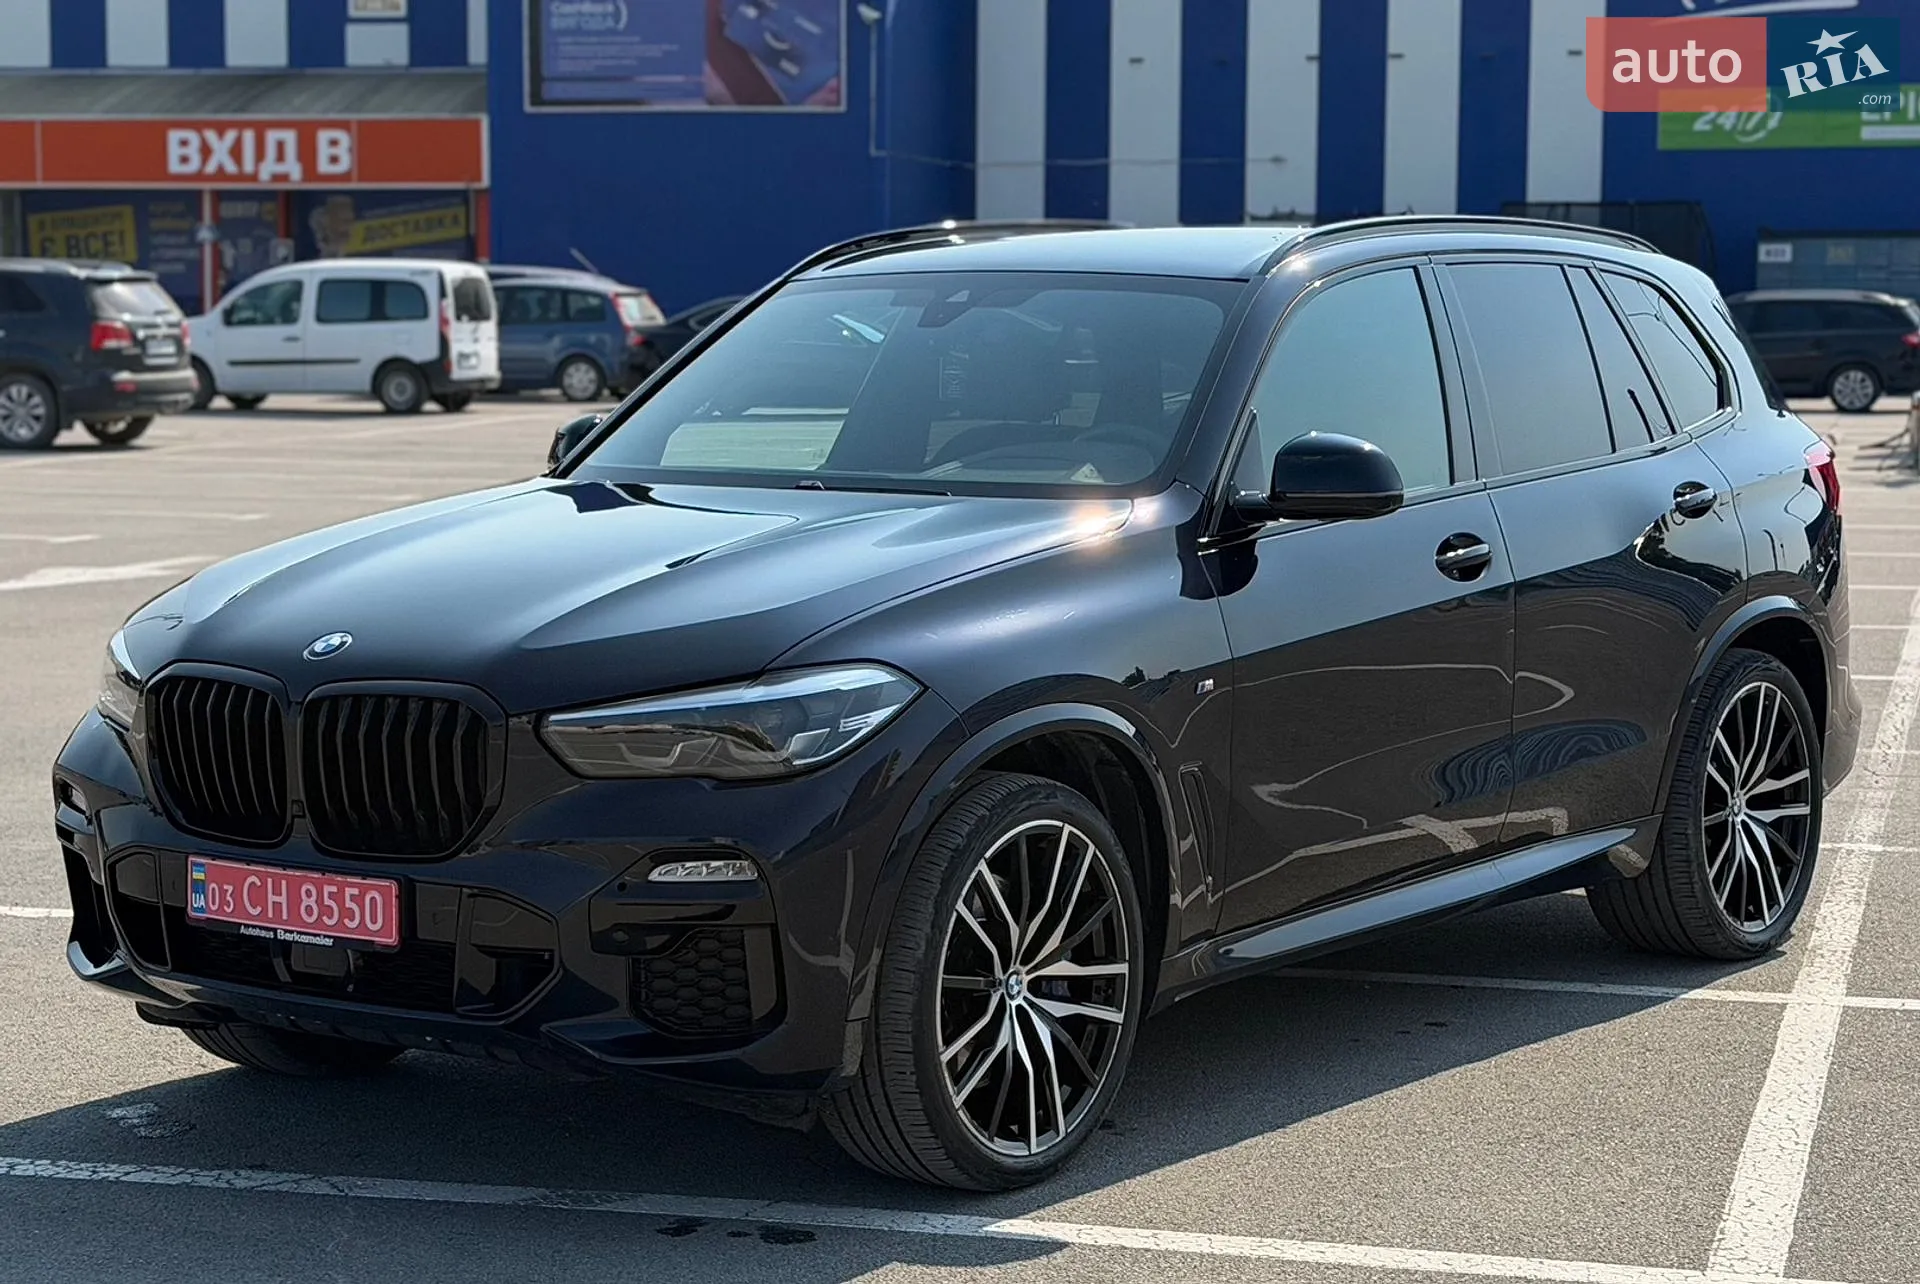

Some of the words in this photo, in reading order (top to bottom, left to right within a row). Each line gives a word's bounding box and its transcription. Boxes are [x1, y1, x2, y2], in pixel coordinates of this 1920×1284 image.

[167, 129, 303, 181] ВХІД
[316, 129, 352, 174] В
[192, 893, 206, 909] UA
[208, 882, 235, 913] 03
[242, 875, 289, 920] CH
[300, 882, 384, 932] 8550
[240, 925, 275, 938] Autohaus
